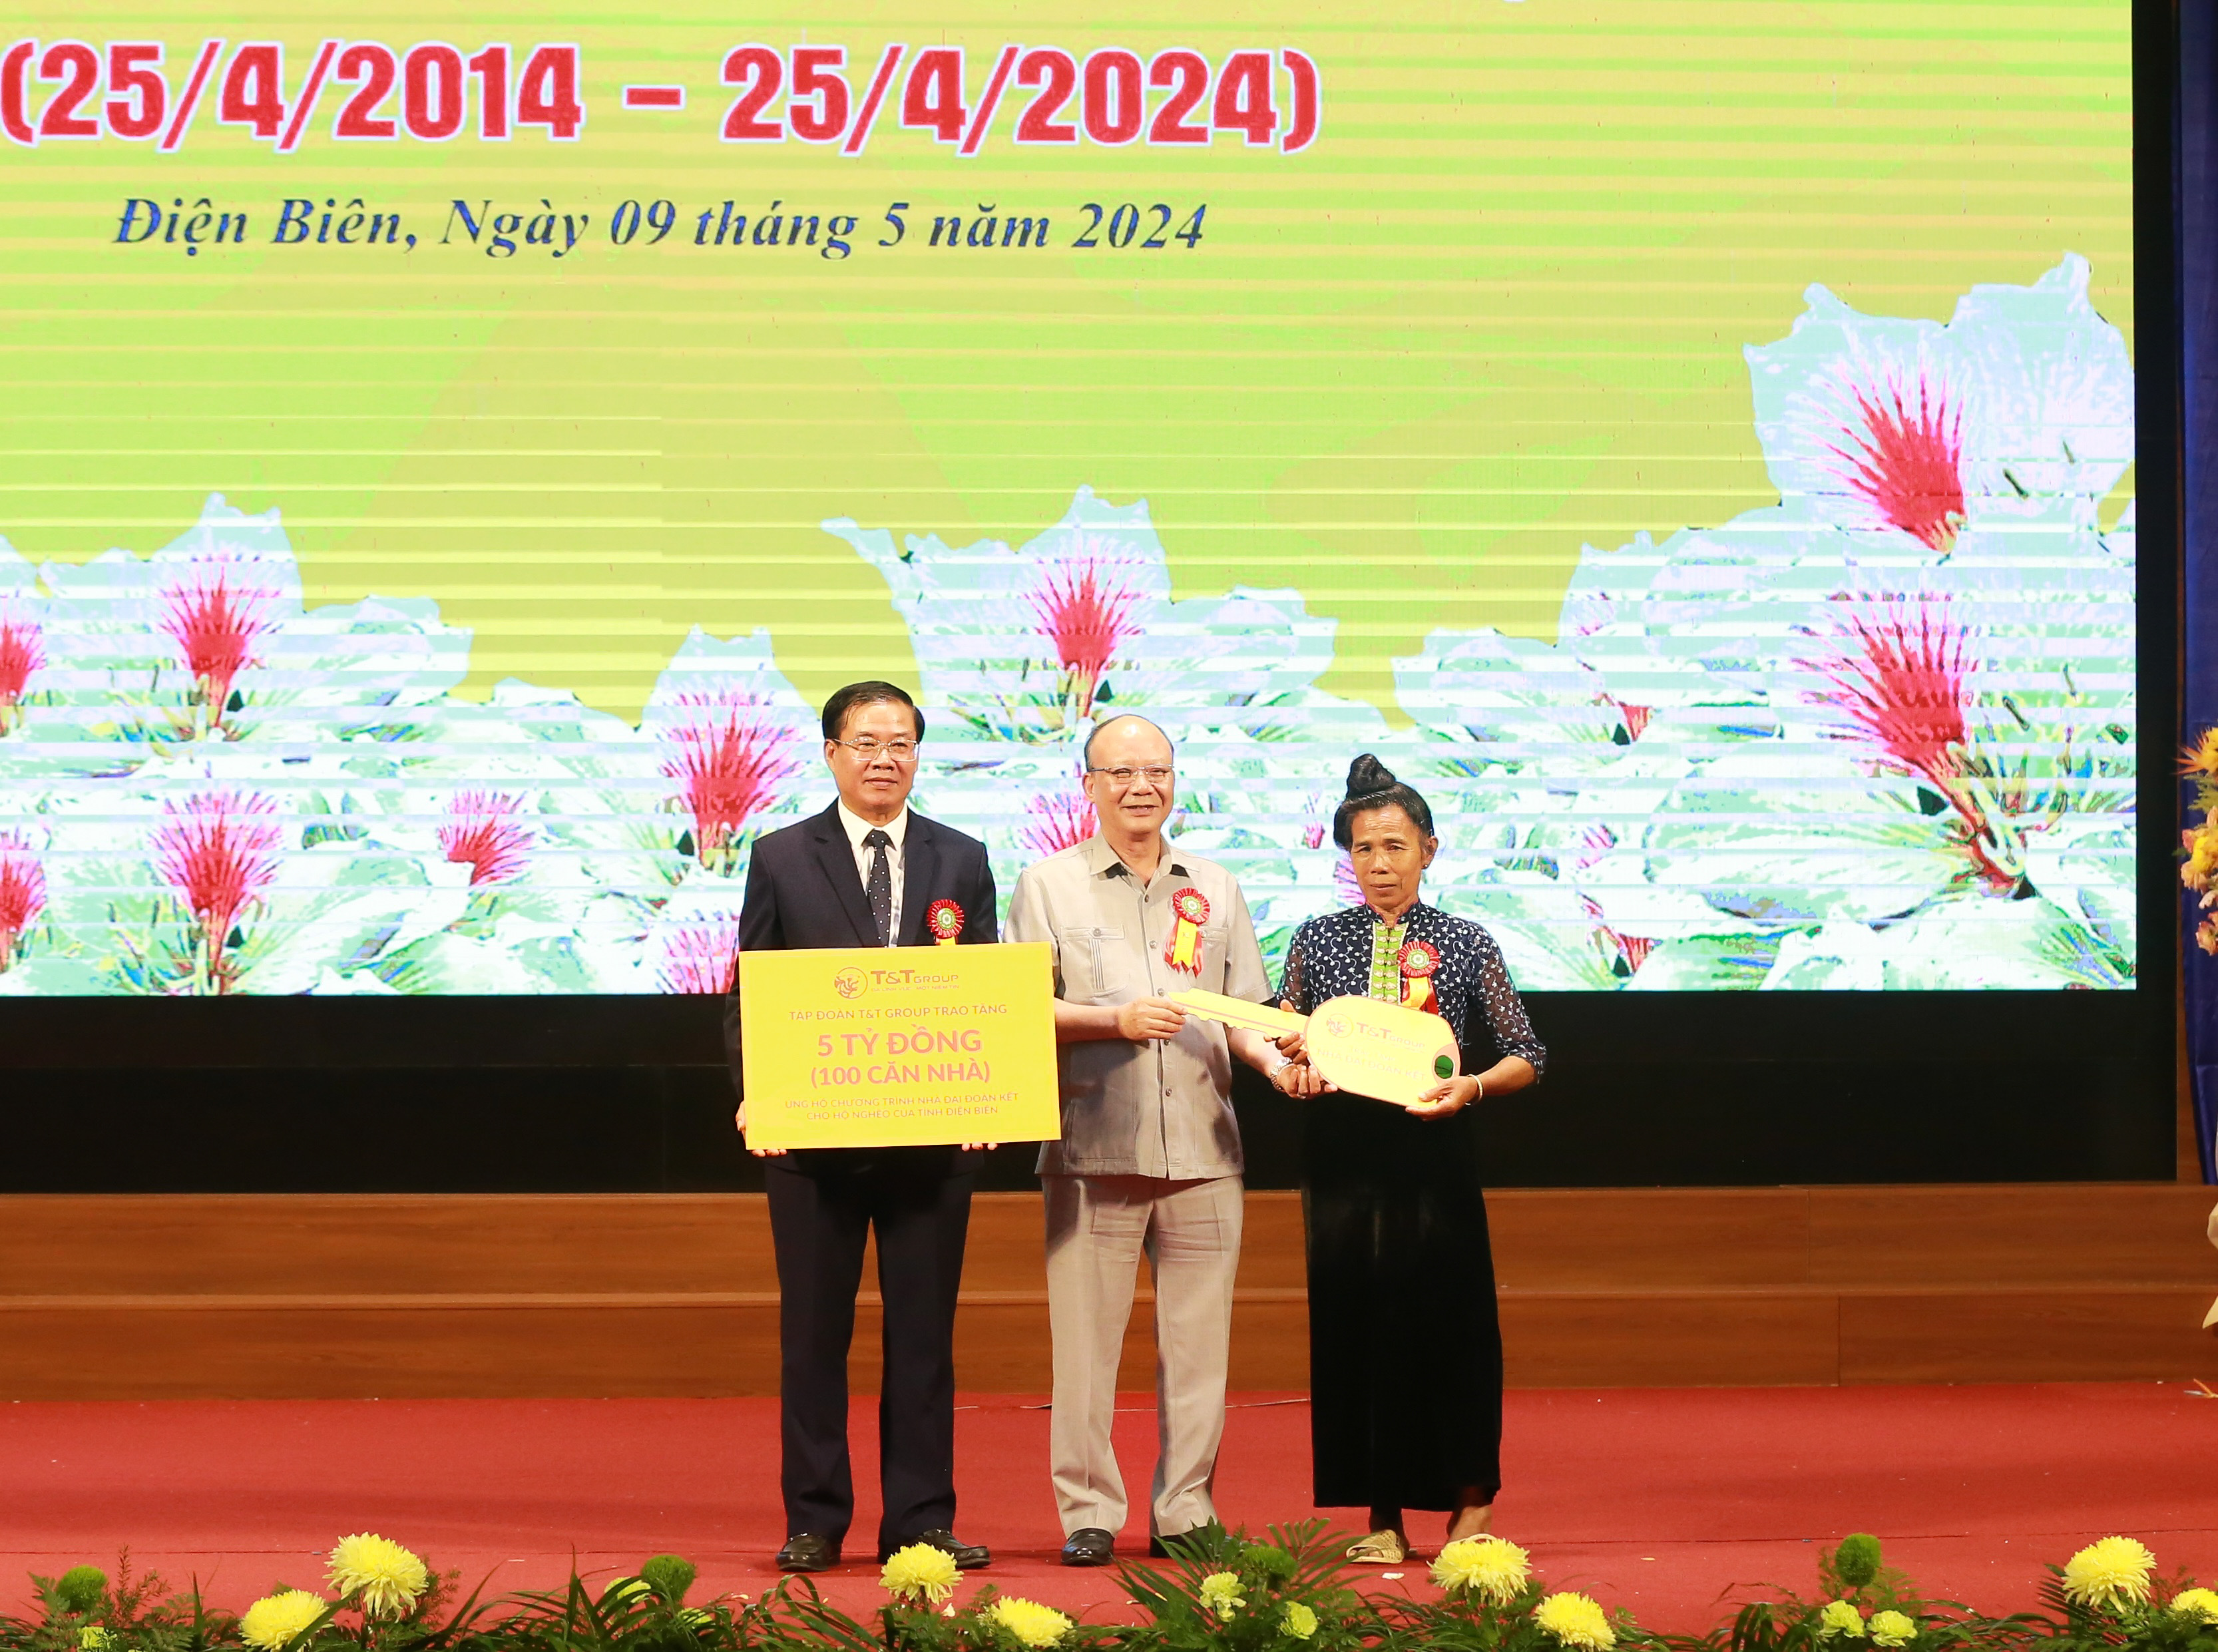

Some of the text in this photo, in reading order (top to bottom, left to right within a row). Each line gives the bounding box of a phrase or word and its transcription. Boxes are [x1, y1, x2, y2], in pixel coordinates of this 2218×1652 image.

[0, 41, 582, 150] (25/4/2014
[723, 45, 1318, 154] 25/4/2024)
[114, 198, 1208, 260] Điện Biên, Ngày 09 tháng 5 năm 2024
[858, 1008, 881, 1018] T&T
[885, 1007, 931, 1018] GROUP
[935, 1006, 969, 1016] TRAO
[817, 1024, 982, 1057] 5 TỶ ĐỒNG
[811, 1058, 991, 1089] (100 CĂN NHÀ)
[807, 1111, 830, 1120] CHO
[830, 1097, 879, 1106] CHƯƠNG
